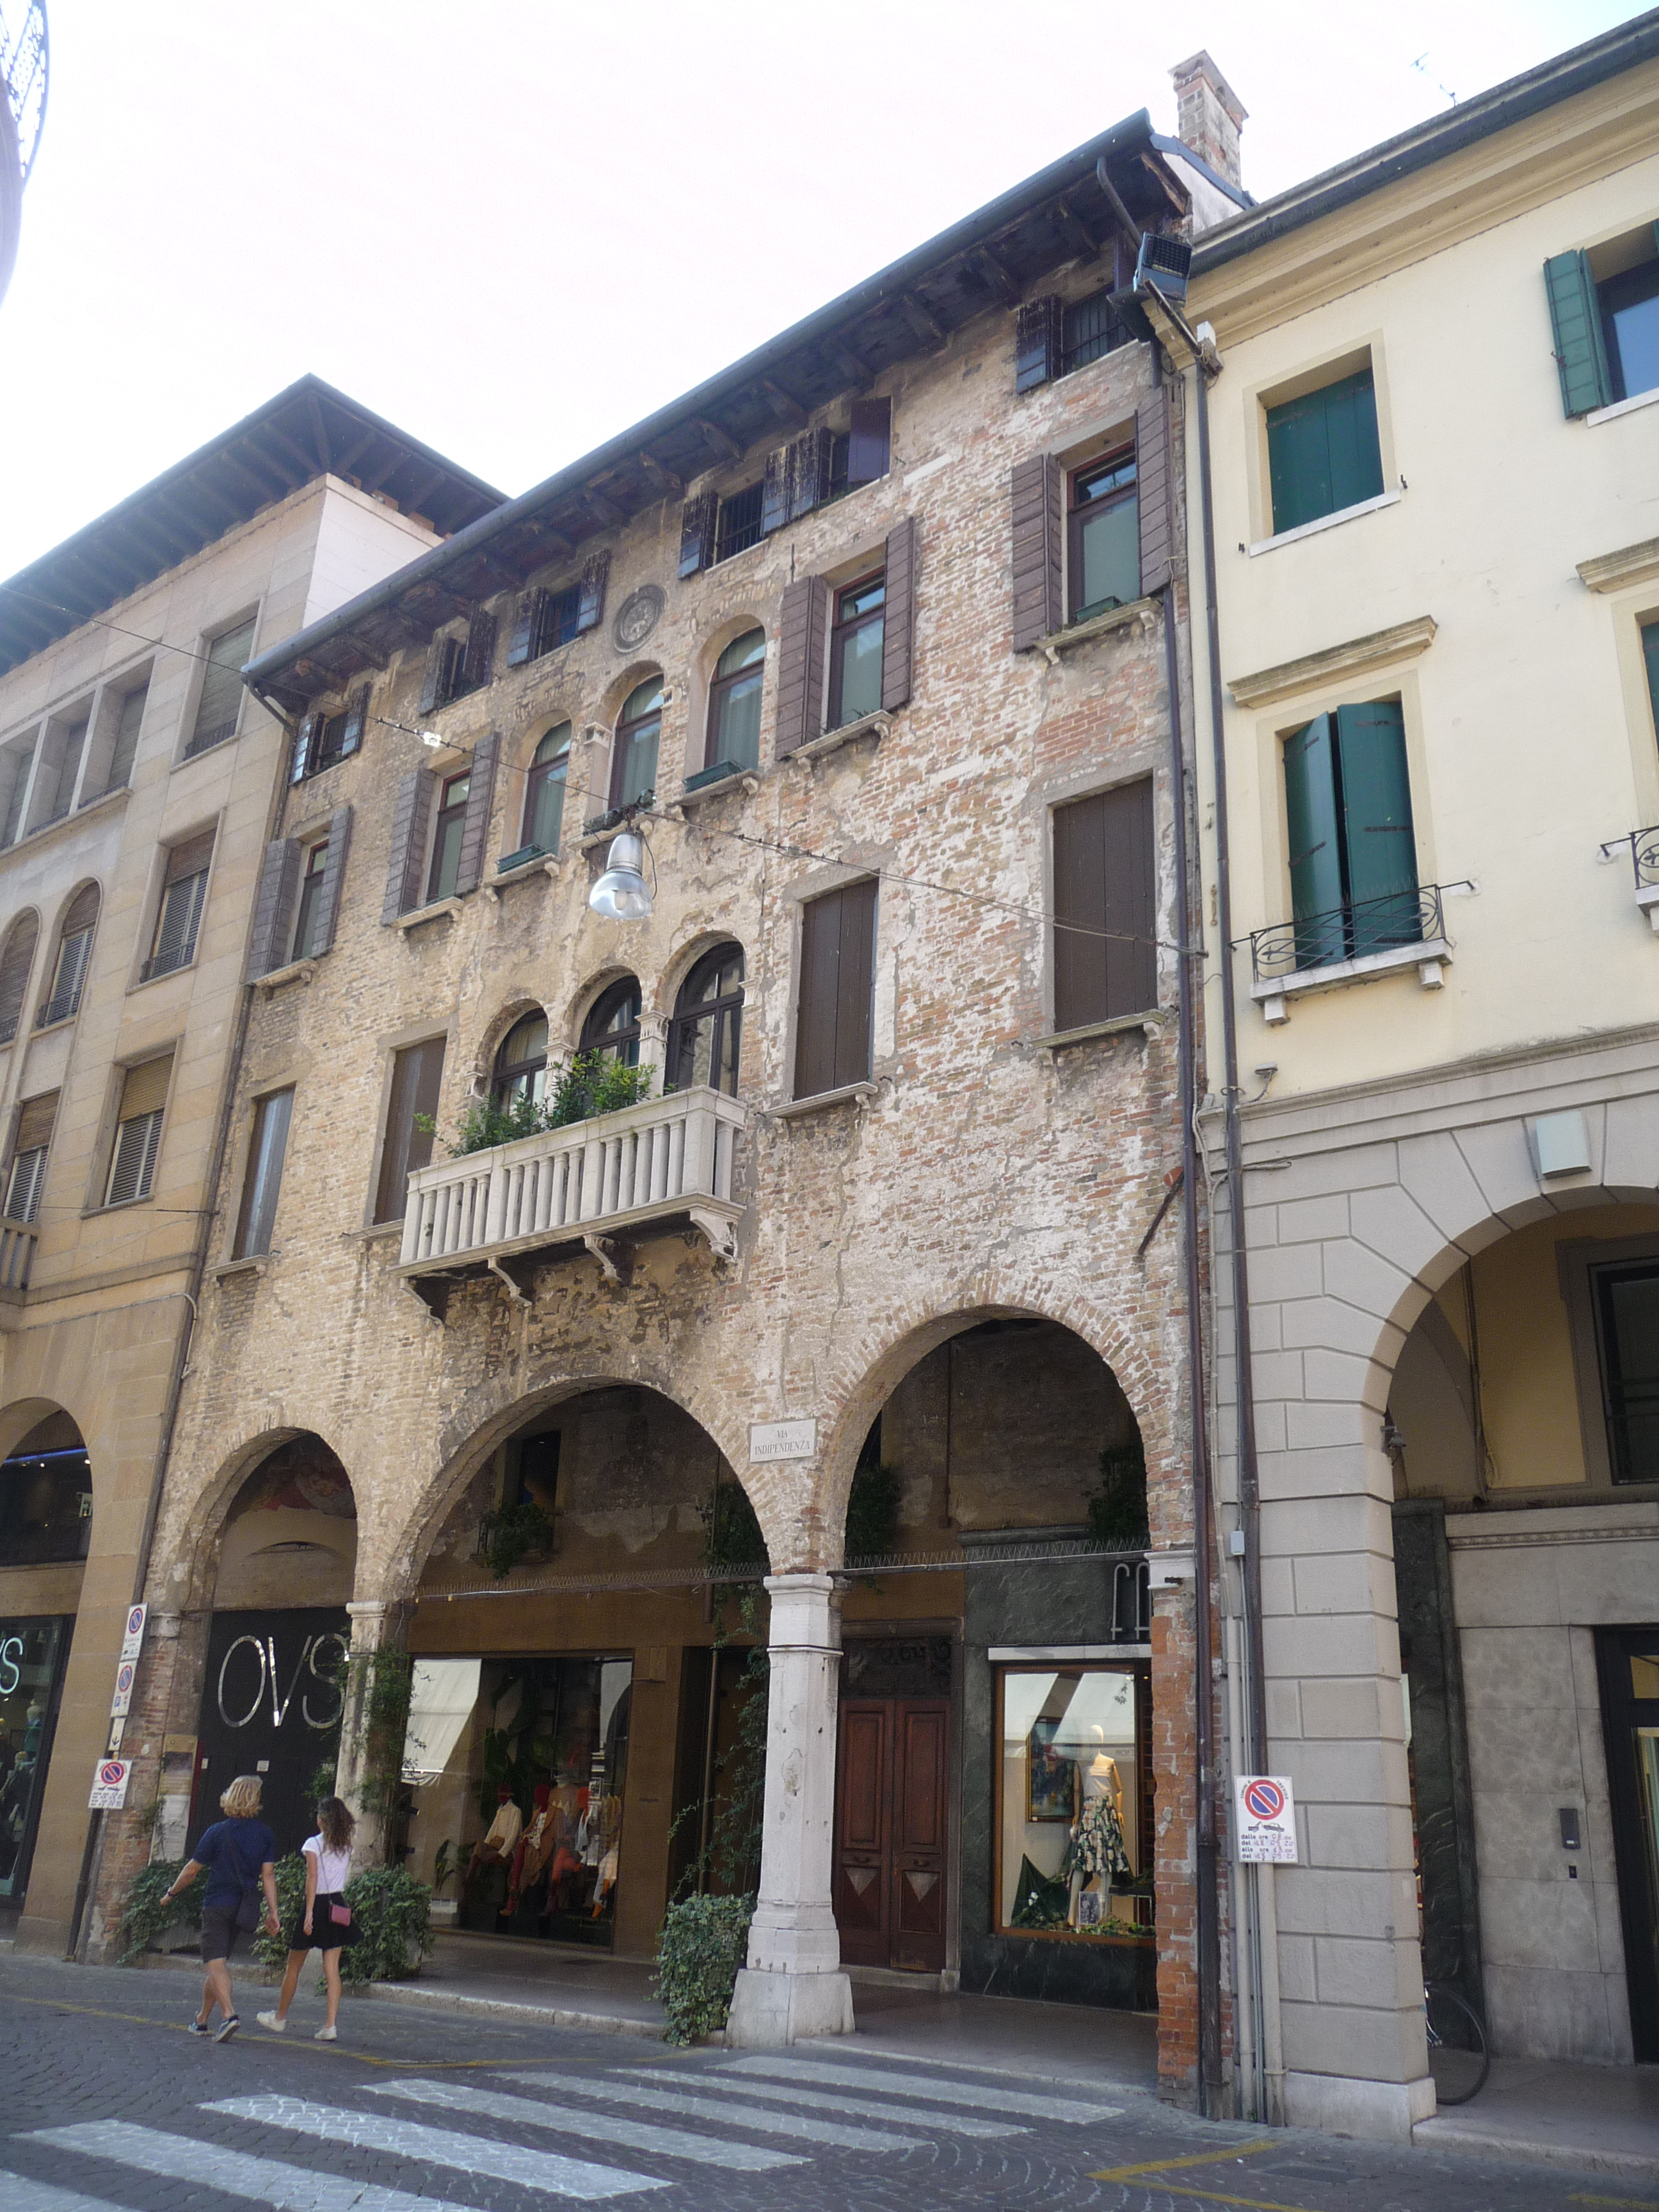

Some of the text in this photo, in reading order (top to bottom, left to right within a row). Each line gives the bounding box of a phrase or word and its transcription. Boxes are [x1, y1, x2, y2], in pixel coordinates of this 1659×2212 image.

[777, 1430, 788, 1438] VIA
[755, 1440, 810, 1455] INDIPENDENZA
[218, 1633, 349, 1729] OVS
